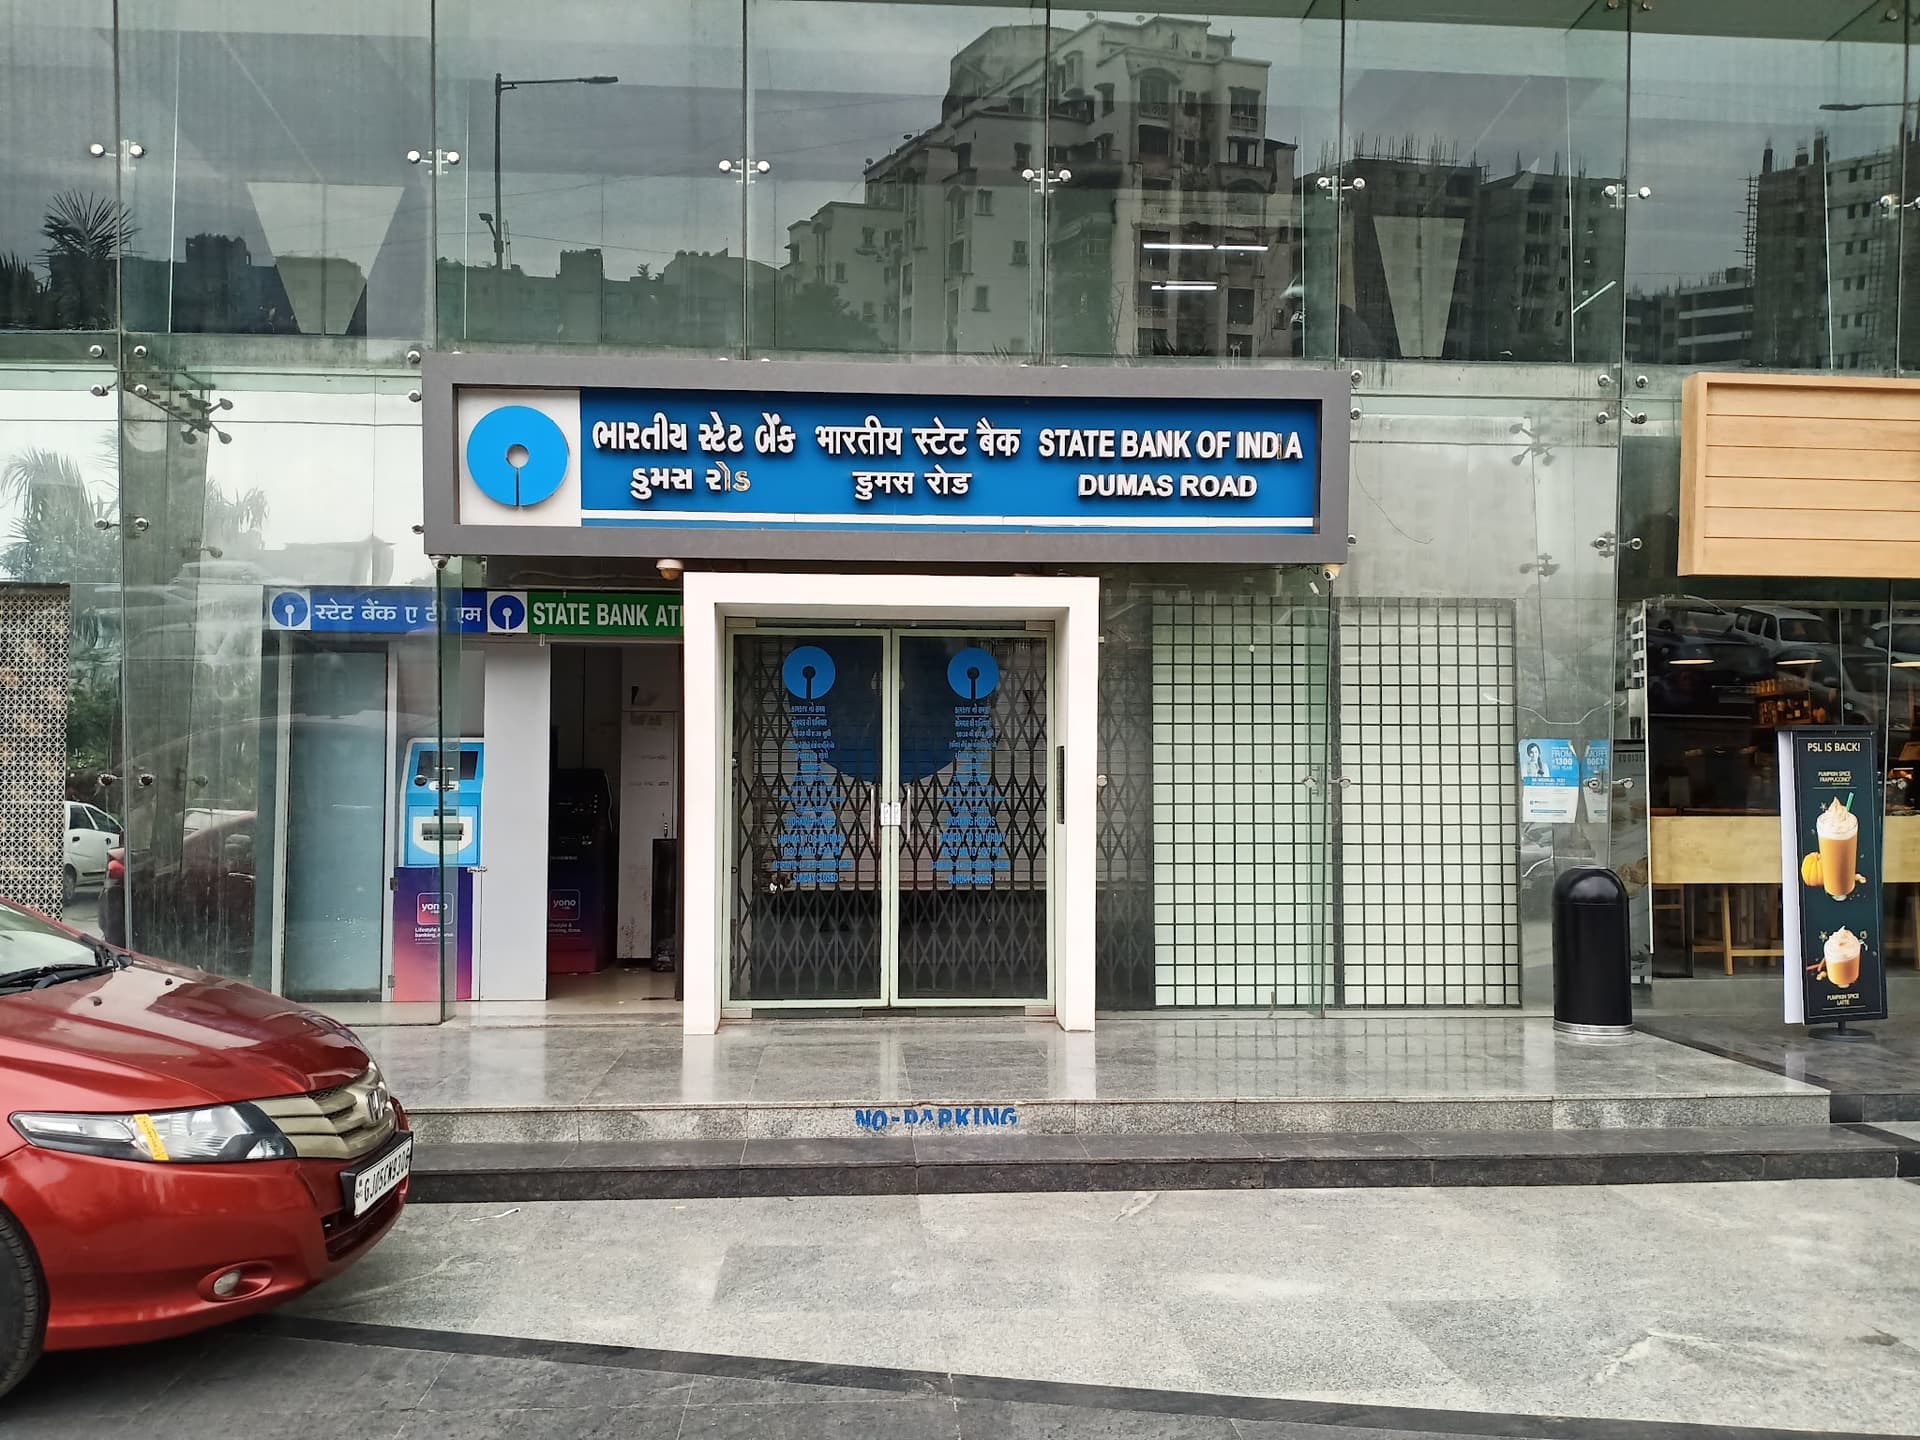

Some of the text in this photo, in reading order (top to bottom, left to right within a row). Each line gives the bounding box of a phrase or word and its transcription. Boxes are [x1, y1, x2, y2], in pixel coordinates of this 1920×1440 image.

[592, 412, 688, 451] ભારતીય
[698, 411, 744, 452] સ્ટેટ
[815, 415, 903, 455] भारतीय
[911, 416, 968, 455] स्टेट
[1039, 428, 1303, 460] STATE BANK OF INDIA
[630, 461, 751, 500] ડુમસ રોડ
[852, 464, 972, 500] डुमस रोड
[1078, 474, 1257, 497] DUMAS ROAD
[315, 598, 354, 621] स्टेट
[361, 598, 397, 621] बैंक
[405, 606, 417, 624] ए
[533, 602, 684, 627] STATE BANK AT
[1807, 742, 1860, 752] PSL IS BACK!
[553, 898, 577, 908] yono
